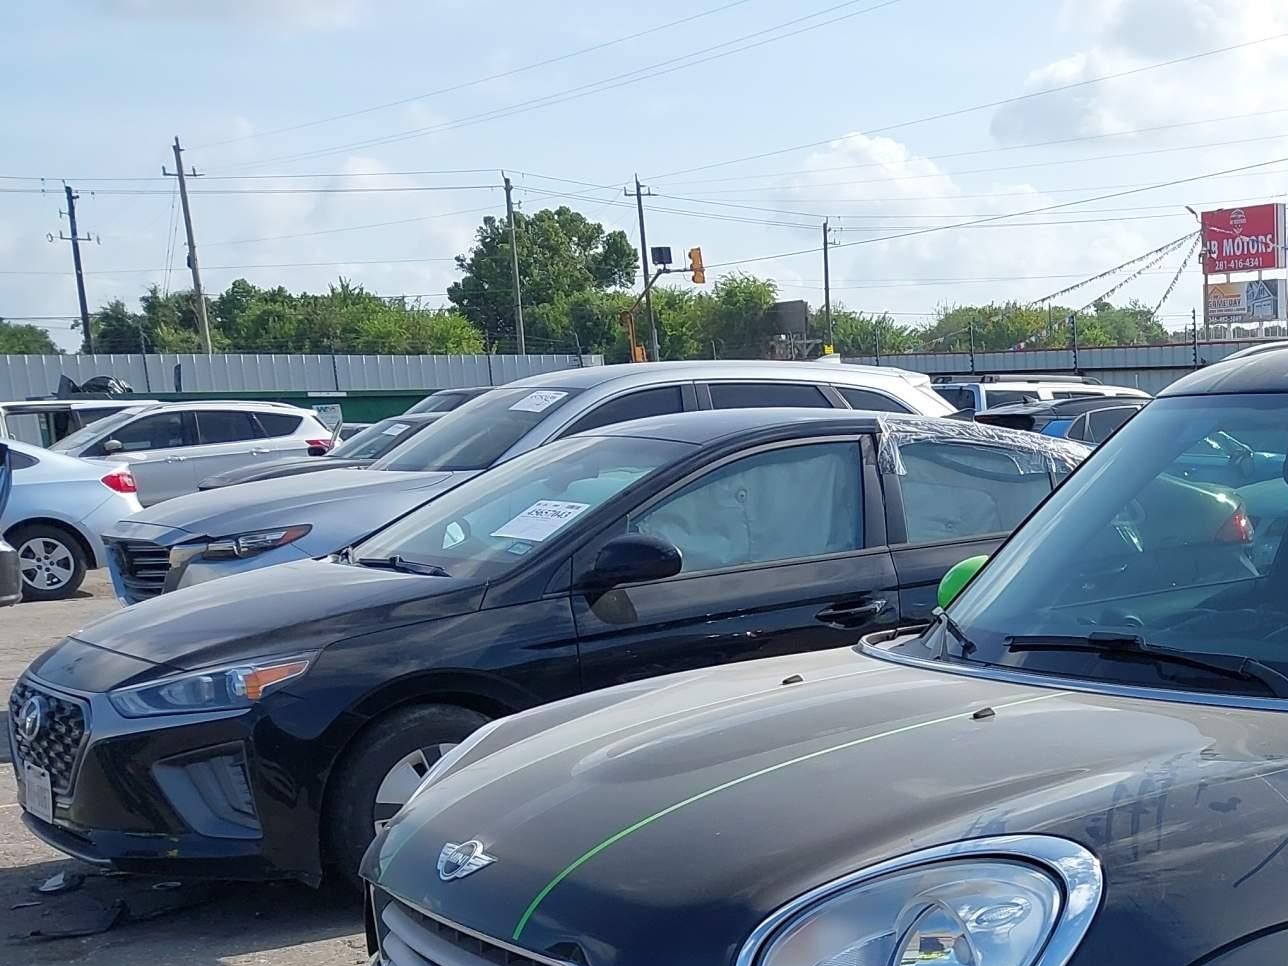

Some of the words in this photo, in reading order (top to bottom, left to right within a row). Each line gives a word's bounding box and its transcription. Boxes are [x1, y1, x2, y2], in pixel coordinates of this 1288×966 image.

[1223, 234, 1273, 257] MOTORS
[1215, 257, 1263, 270] 281-416-4341
[447, 851, 470, 865] MINI
